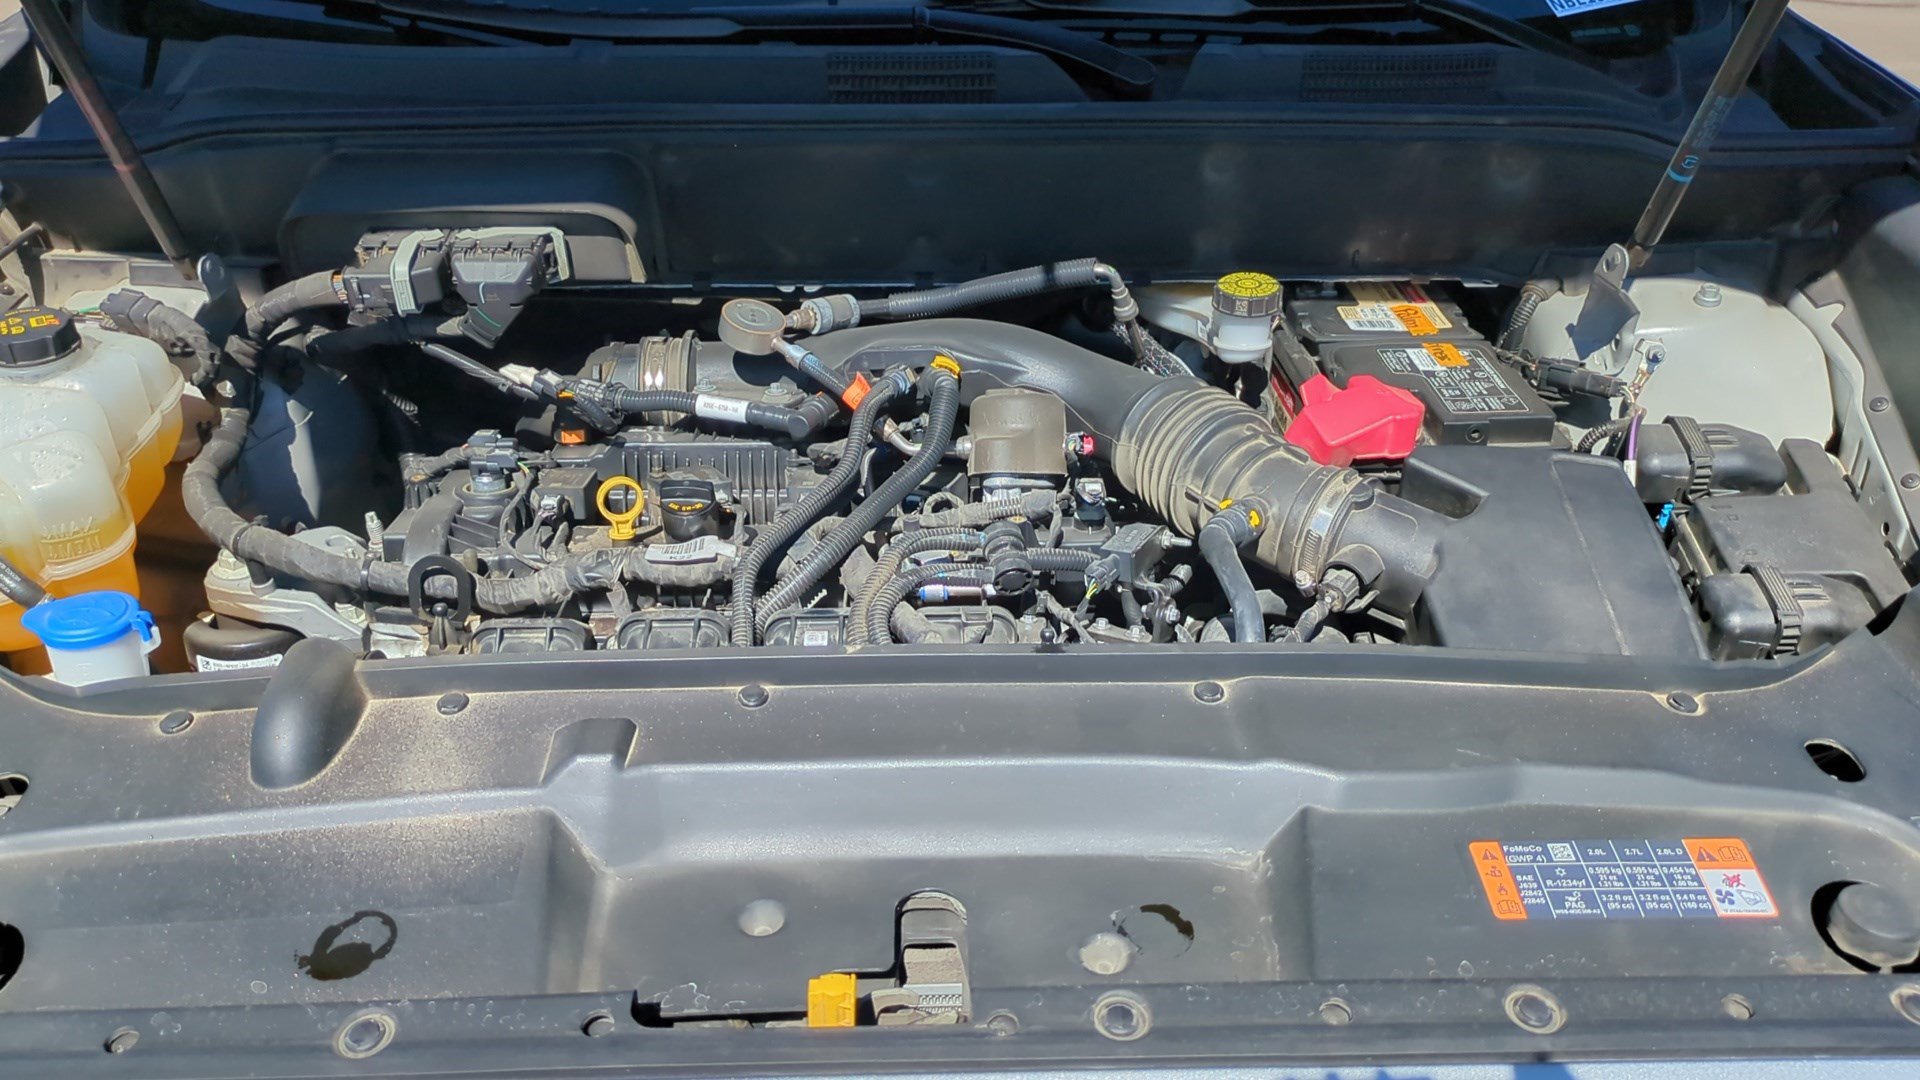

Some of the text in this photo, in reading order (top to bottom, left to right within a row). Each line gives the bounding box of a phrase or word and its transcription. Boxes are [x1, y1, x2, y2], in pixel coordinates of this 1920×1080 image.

[1503, 845, 1542, 853] FoMoCo
[1624, 848, 1644, 856] 2.7L
[1505, 855, 1547, 863] (GWP 4)
[1611, 867, 1622, 875] kg
[1647, 867, 1659, 875] kg
[1684, 866, 1696, 875] kg
[1565, 901, 1586, 909] PAG
[1621, 902, 1635, 910] cc)
[1660, 901, 1673, 910] cc)
[1698, 901, 1712, 910] cc)
